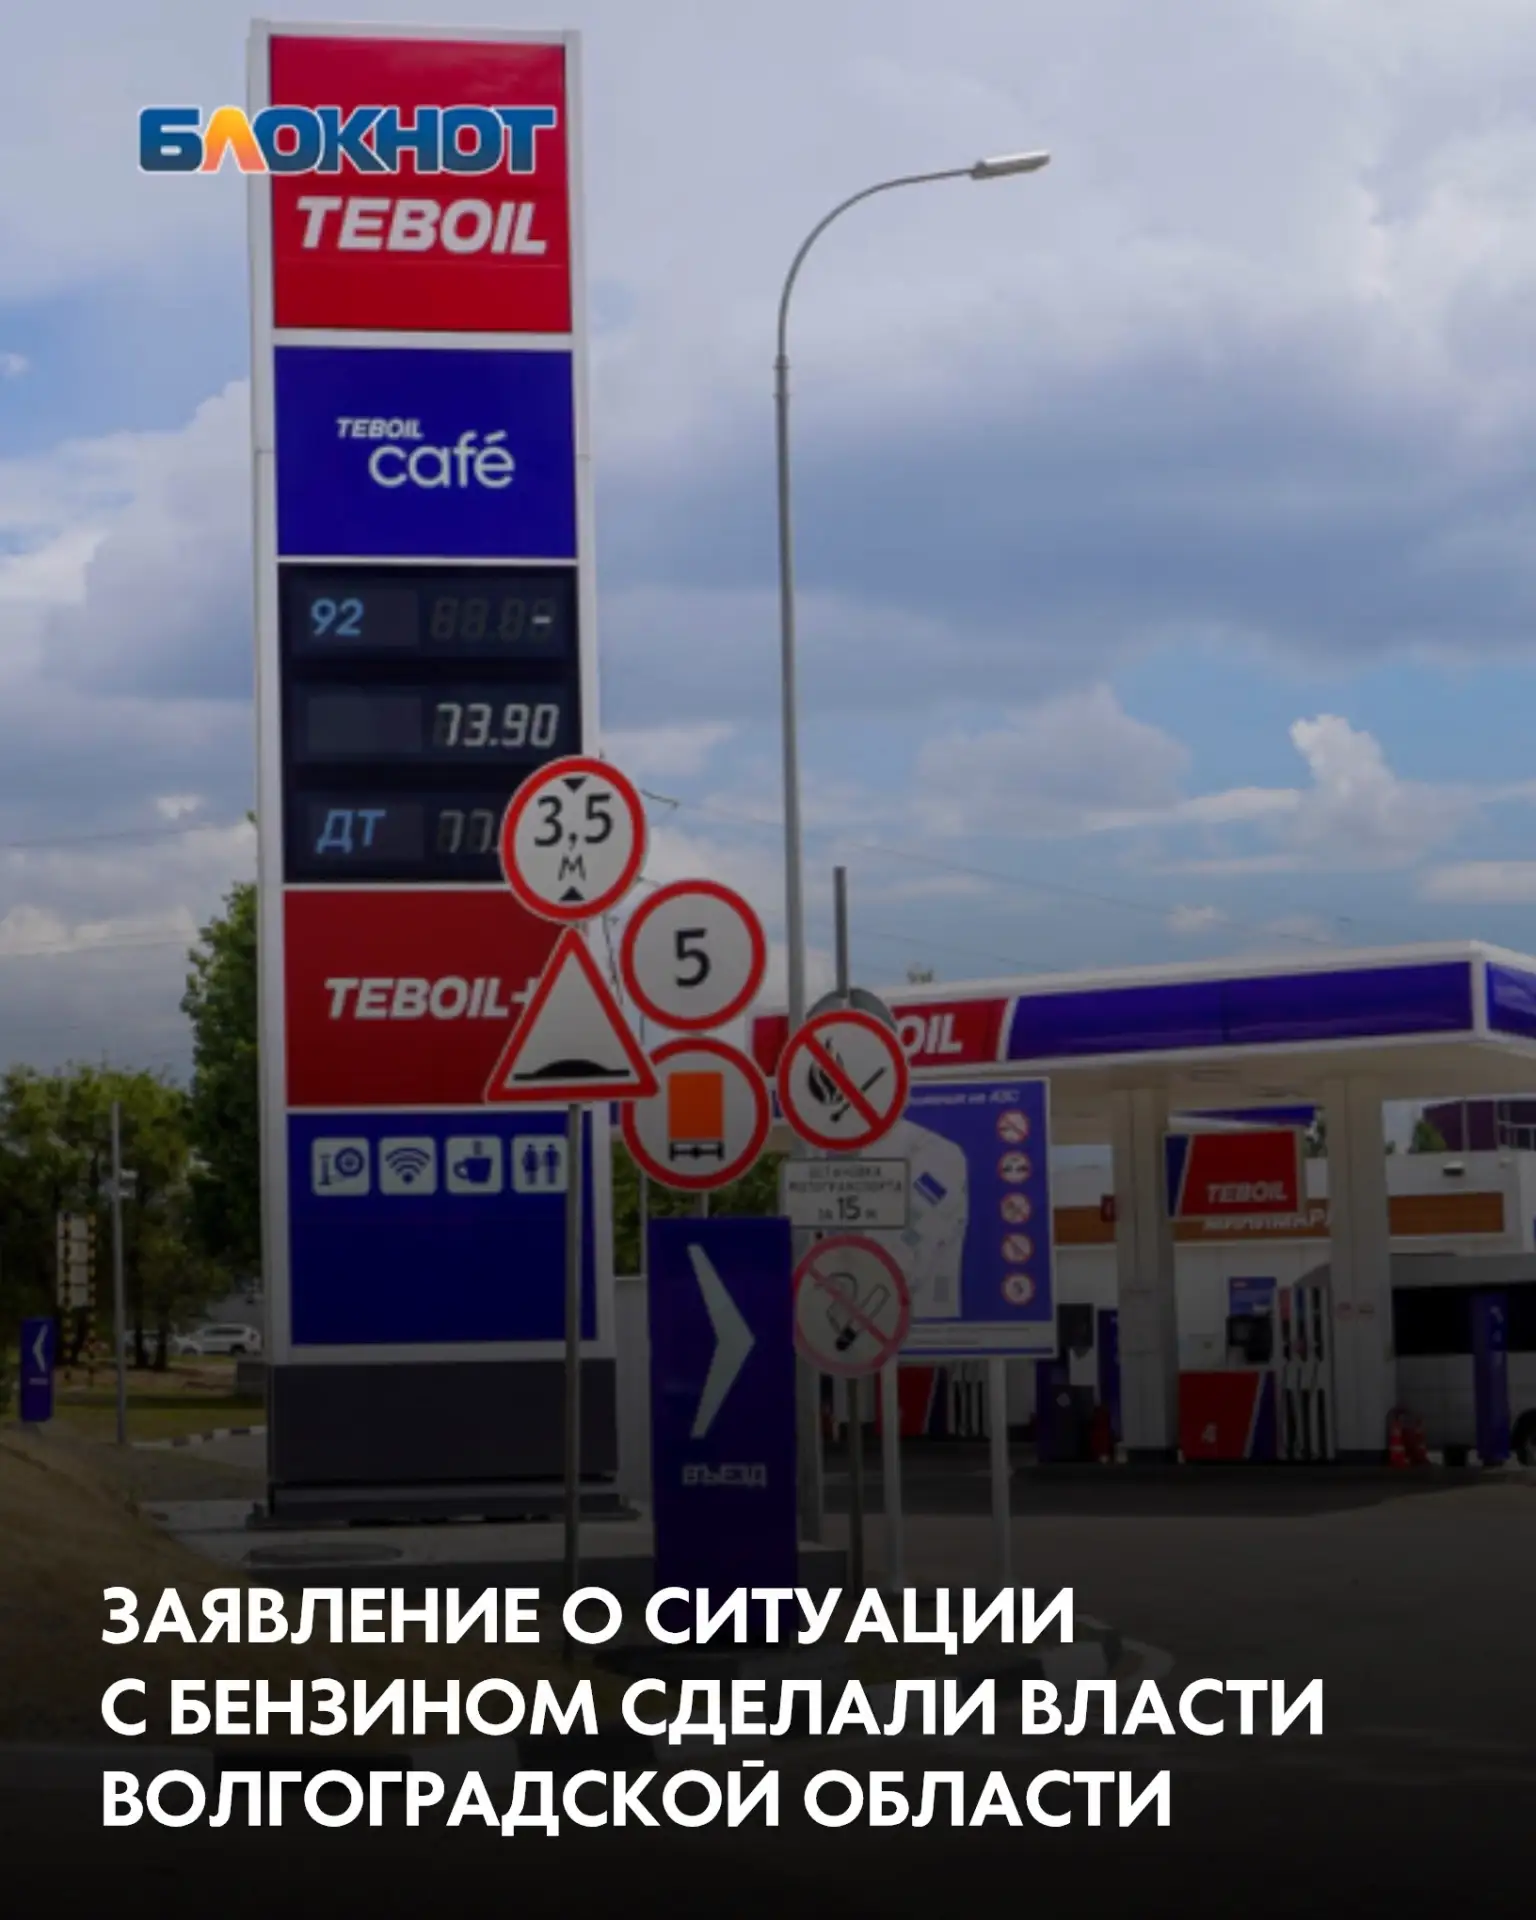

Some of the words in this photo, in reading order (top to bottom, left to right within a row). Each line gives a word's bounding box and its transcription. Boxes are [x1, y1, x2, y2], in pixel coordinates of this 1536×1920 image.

[297, 196, 547, 255] TEBOIL
[336, 418, 424, 440] TEBOIL
[368, 431, 516, 489] café
[310, 597, 364, 637] 92
[436, 702, 560, 748] 73.90
[315, 808, 387, 855] ДТ
[534, 793, 614, 852] 3,5
[674, 927, 712, 988] 5
[837, 1195, 861, 1220] 15
[1206, 1180, 1288, 1204] TEBOIL
